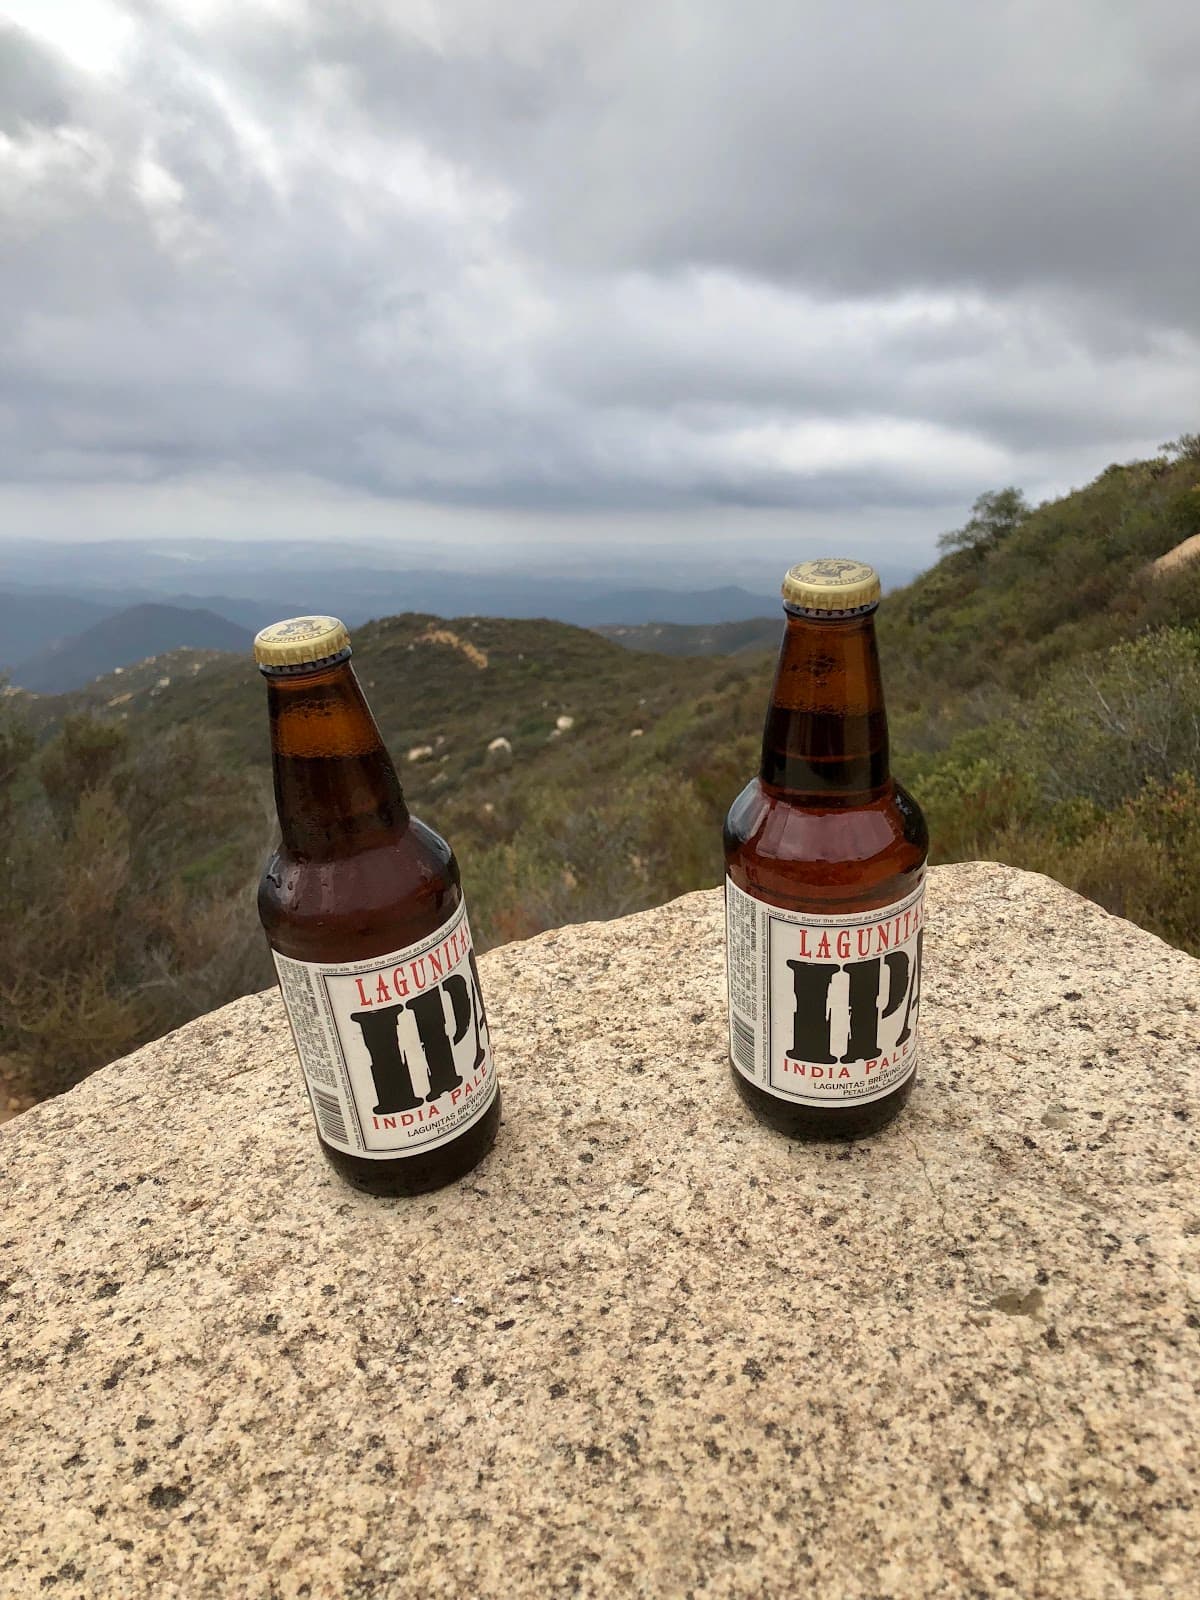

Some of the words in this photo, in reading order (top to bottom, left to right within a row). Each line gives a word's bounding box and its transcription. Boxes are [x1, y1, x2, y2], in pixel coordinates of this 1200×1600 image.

[783, 1058, 850, 1079] INDIA
[865, 1041, 909, 1075] PALE
[813, 1080, 865, 1090] LAGUNITAS
[867, 1064, 901, 1086] BREWING
[372, 1104, 440, 1130] INDIA
[450, 1062, 487, 1106] PALE
[407, 1111, 456, 1138] LAGUNITAS
[457, 1086, 485, 1115] BREWING
